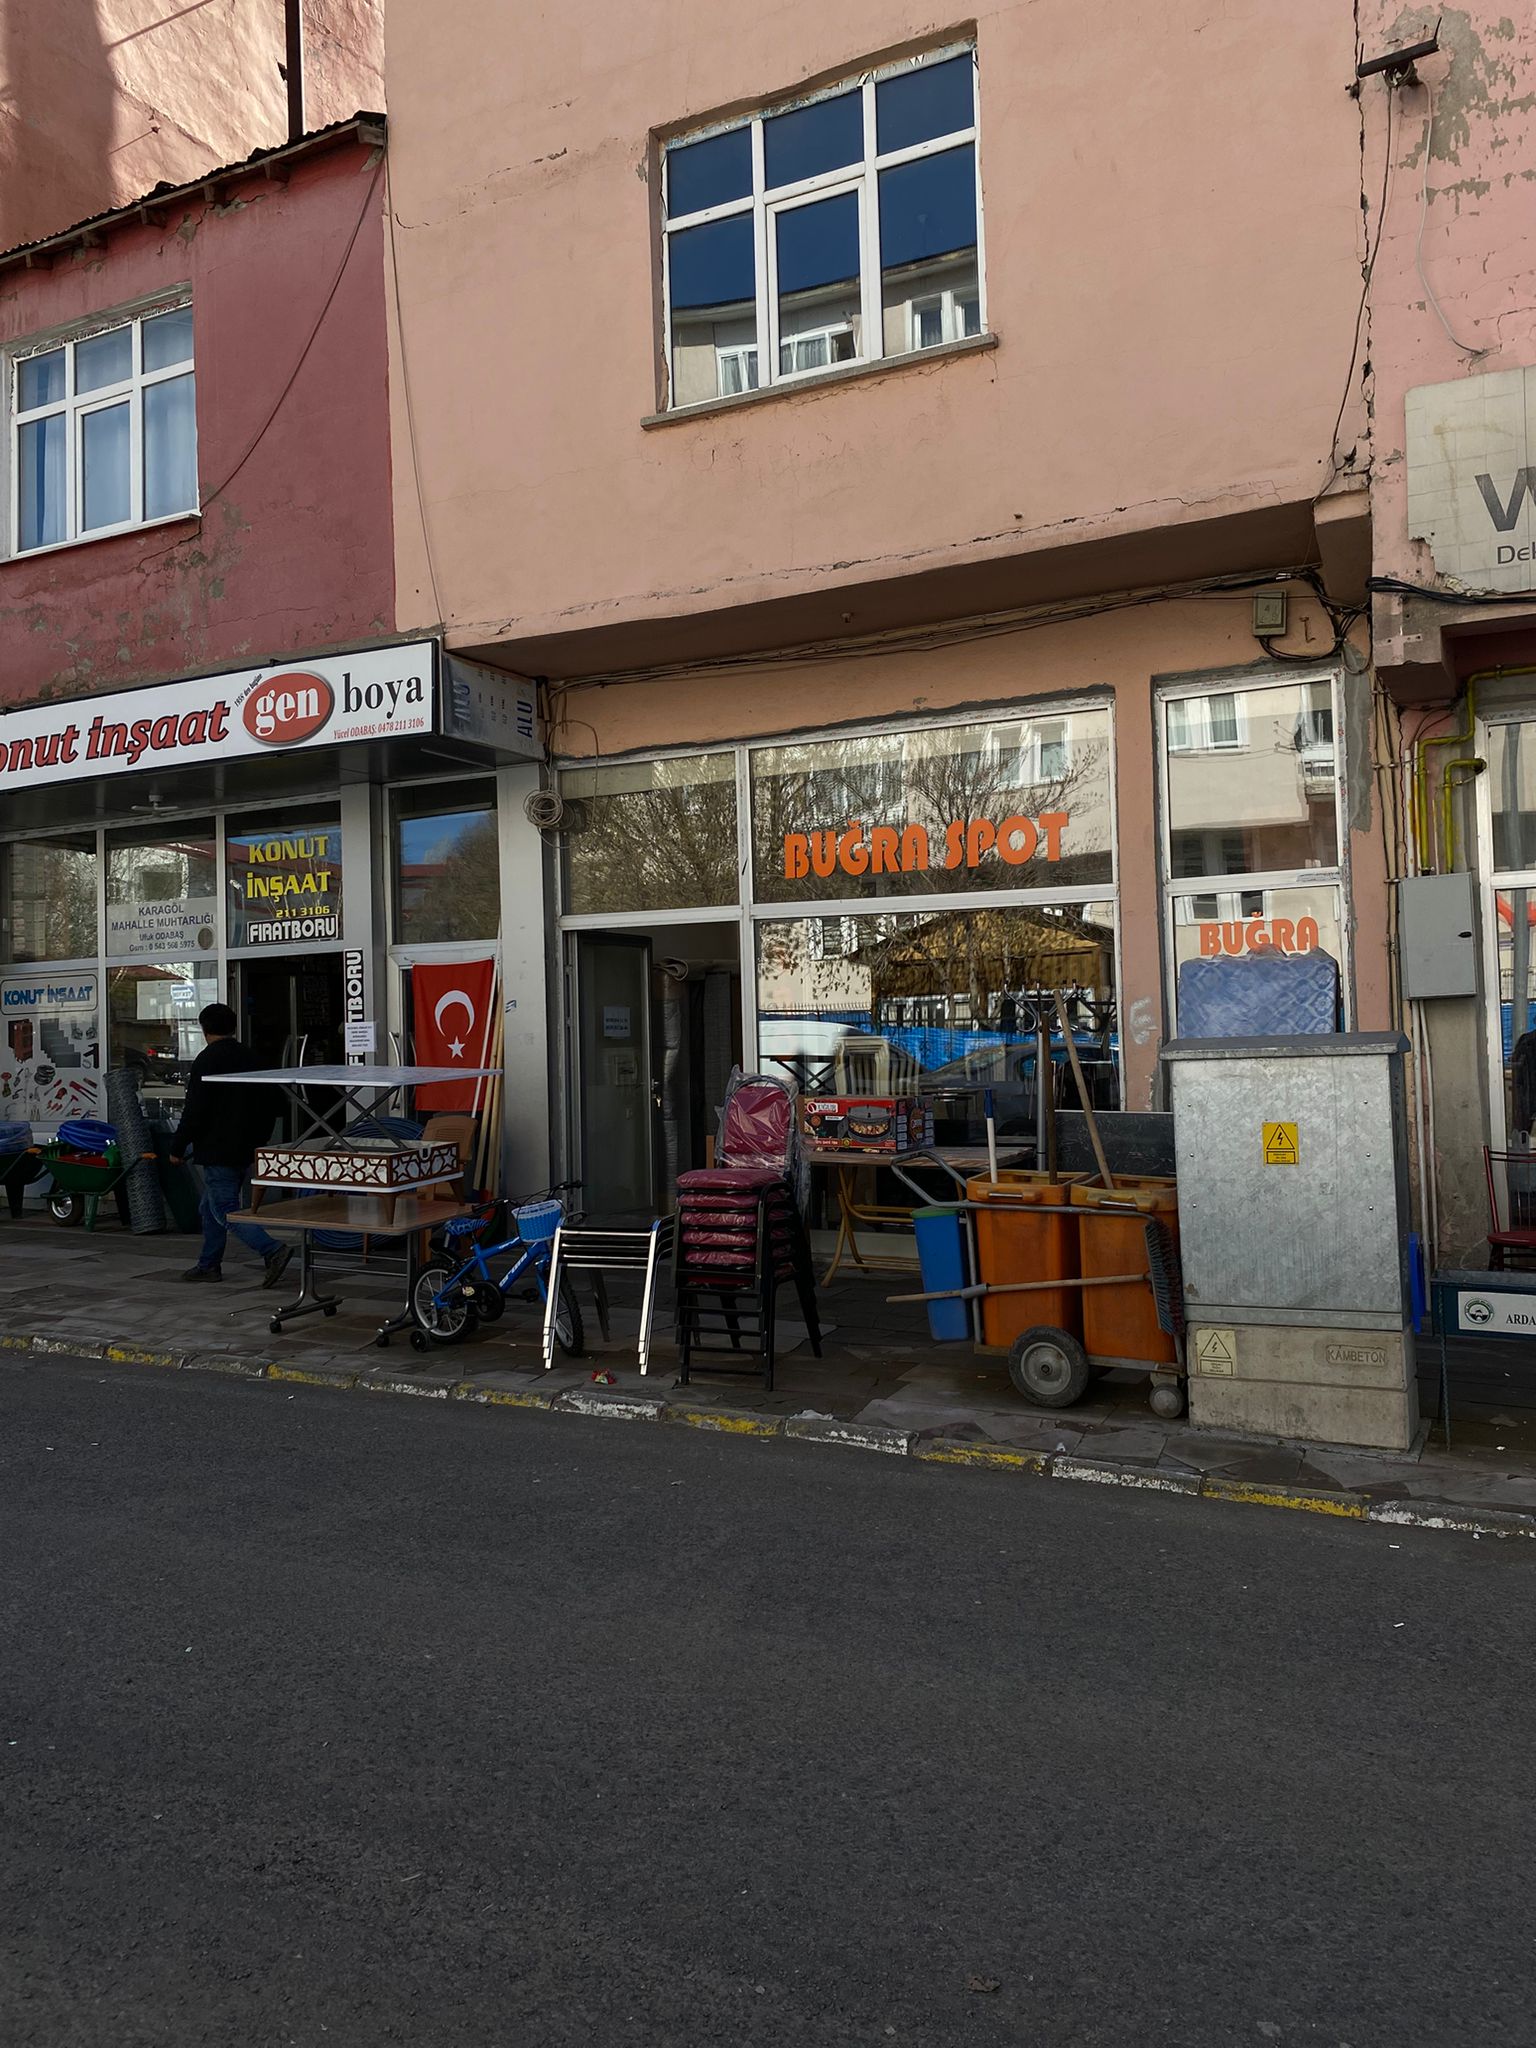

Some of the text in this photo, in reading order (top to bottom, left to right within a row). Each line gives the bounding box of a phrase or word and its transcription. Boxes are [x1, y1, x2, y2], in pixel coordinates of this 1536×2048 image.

[255, 687, 321, 737] gen
[342, 672, 425, 719] boya
[85, 700, 231, 765] inşaat
[378, 721, 394, 733] 0478
[395, 719, 407, 731] 211
[408, 716, 425, 729] 3106
[248, 836, 328, 864] KONUT
[784, 812, 1070, 880] BUĞRA SPOT
[246, 871, 331, 902] İNŞAAT
[111, 912, 214, 931] MAHALLE MUHTARLIĞI
[138, 902, 185, 916] KARAGÖL
[276, 905, 330, 918] 211 3106
[250, 917, 335, 942] FIRATBORU
[1200, 911, 1318, 956] BUĞRA
[4, 984, 93, 1007] KONUT İNŞAAT
[346, 951, 364, 1067] FITBORU
[1327, 1350, 1386, 1363] KAMBETON
